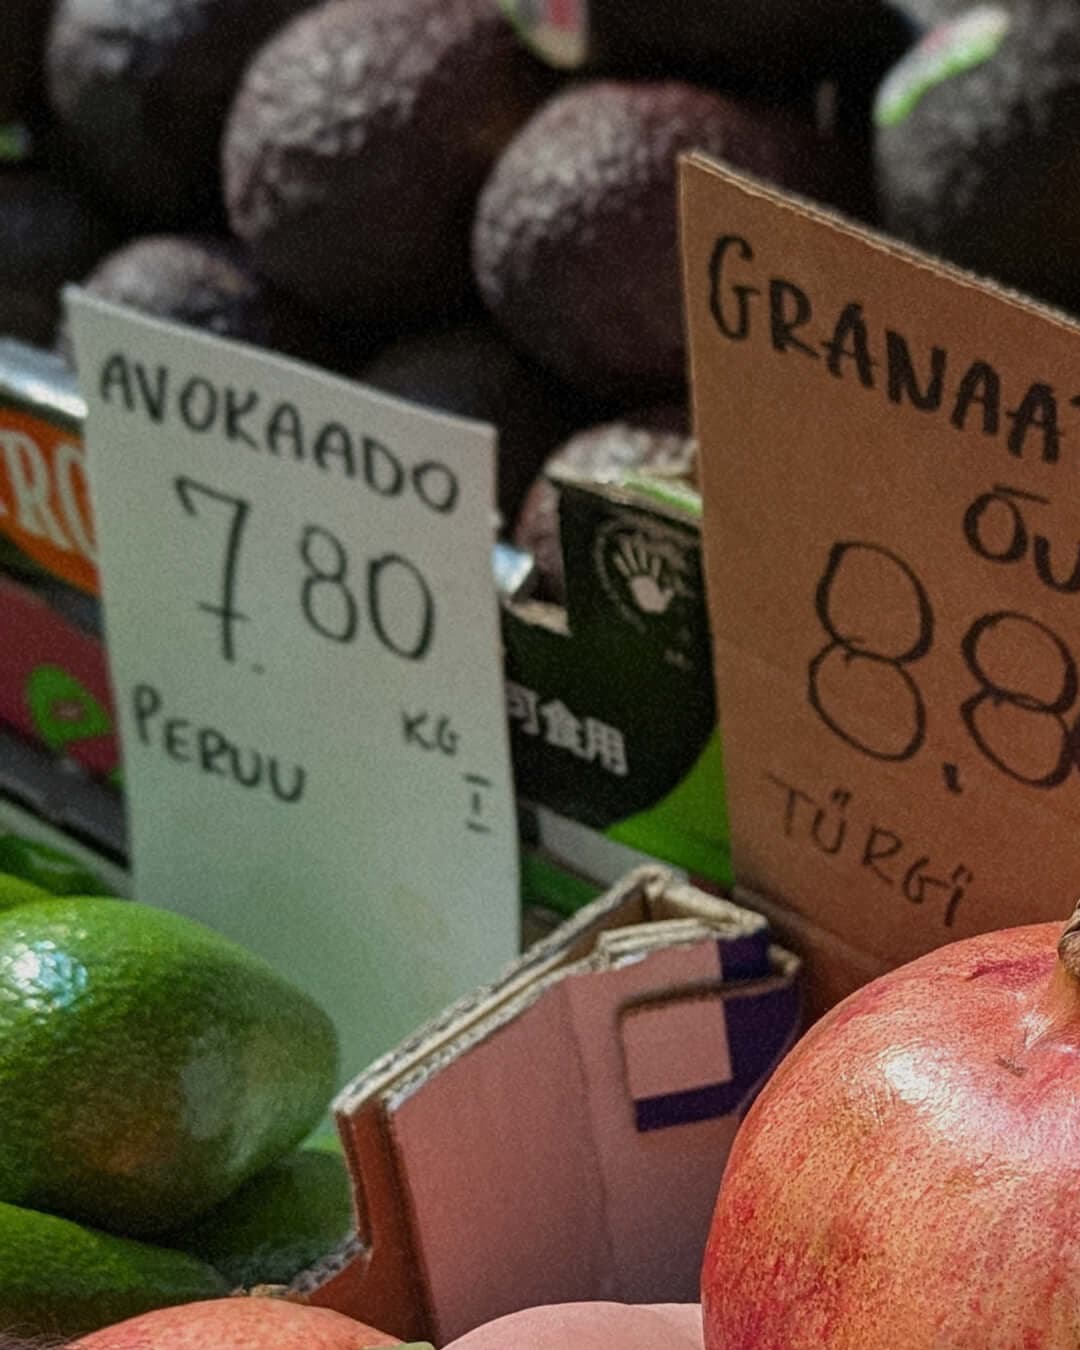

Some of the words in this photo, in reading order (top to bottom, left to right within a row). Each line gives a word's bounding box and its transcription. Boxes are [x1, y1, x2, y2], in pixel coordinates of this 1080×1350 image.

[0, 428, 98, 564] RO
[100, 353, 459, 514] AVOKAADO
[132, 683, 306, 803] PERUU
[401, 710, 460, 756] KG
